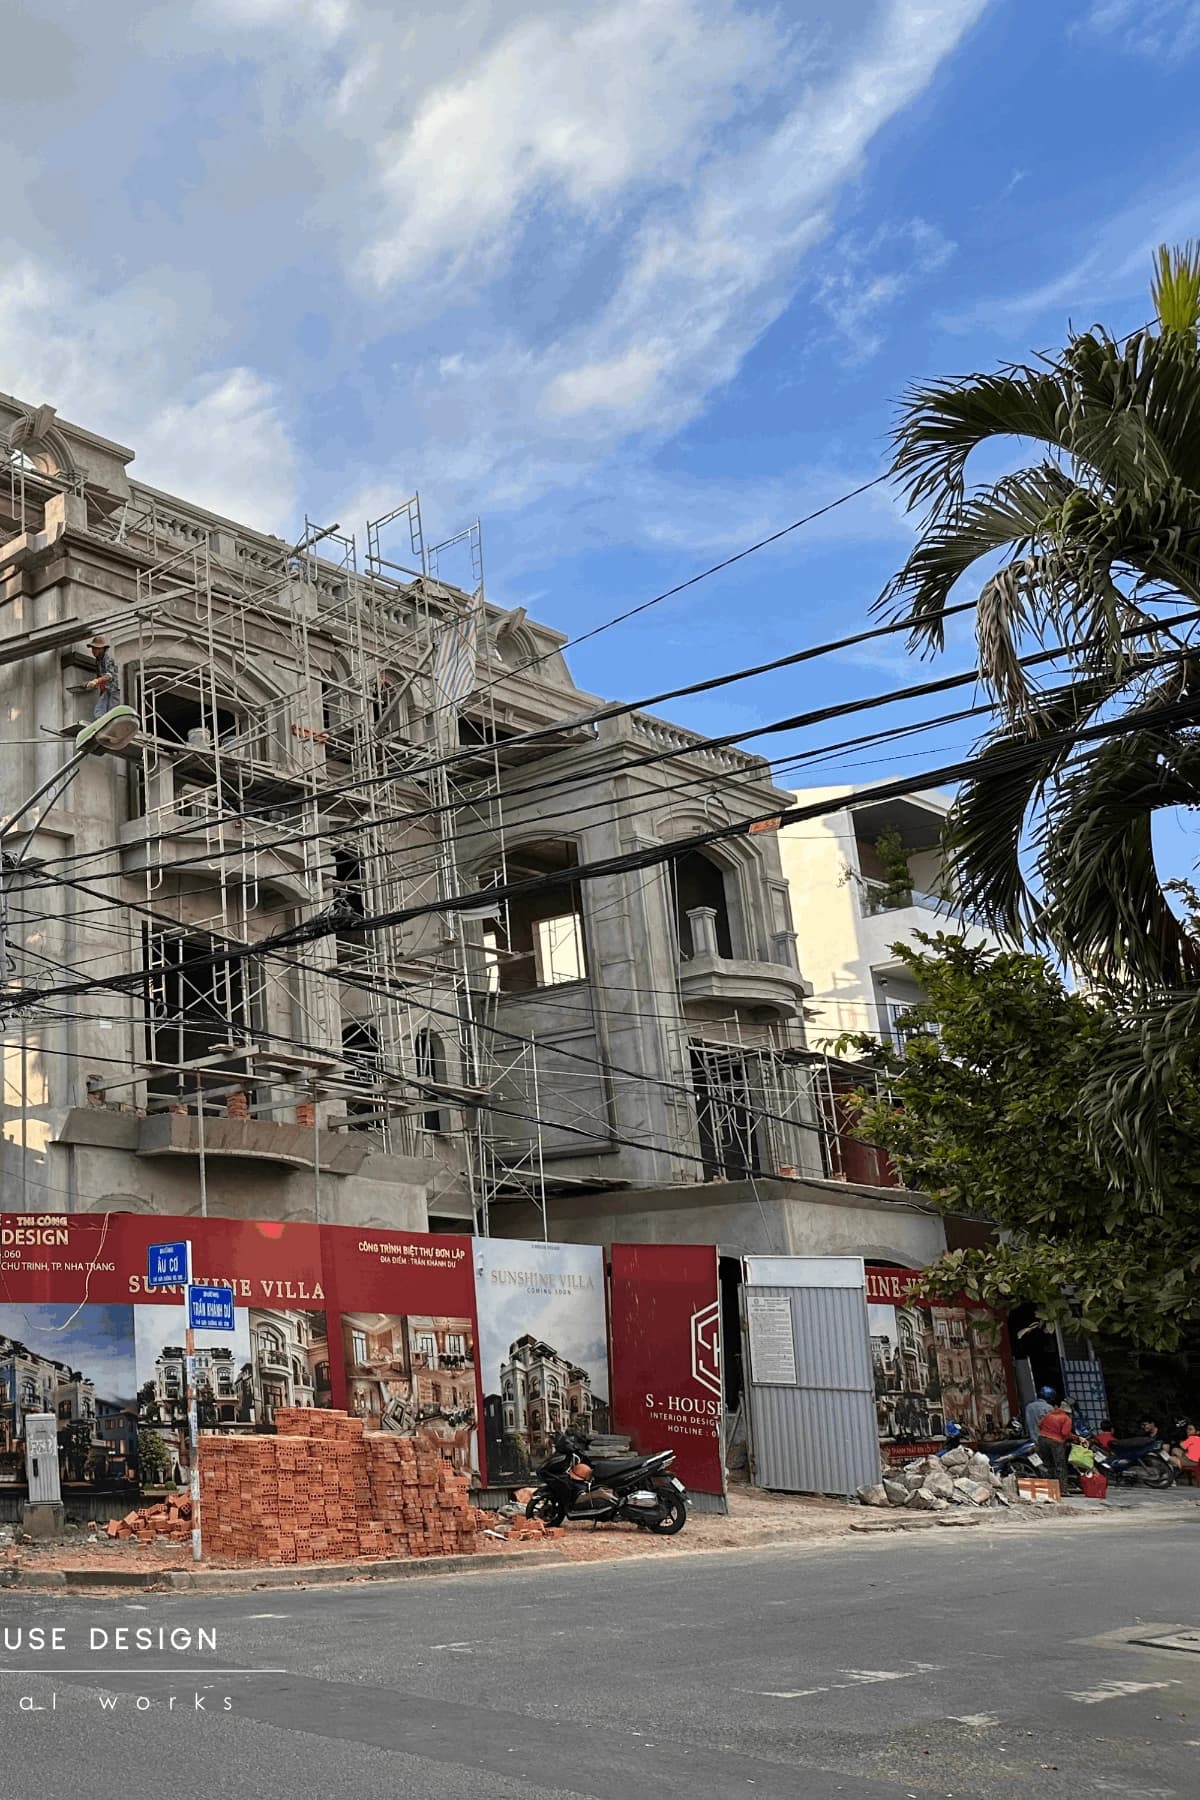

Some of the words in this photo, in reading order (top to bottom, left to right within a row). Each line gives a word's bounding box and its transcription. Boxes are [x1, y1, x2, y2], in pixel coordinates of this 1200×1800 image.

[17, 1216, 35, 1226] THI
[37, 1216, 68, 1226] CÔNG
[1, 1229, 69, 1246] DESIGN
[358, 1241, 378, 1252] CÔNG
[379, 1242, 401, 1254] TRÌNH
[1, 1263, 20, 1271] CHU
[65, 1263, 83, 1271] NHA
[85, 1262, 116, 1271] TRANG
[491, 1270, 556, 1288] SUNSHINE
[558, 1273, 595, 1290] VILLA
[261, 1280, 325, 1300] VILLA
[645, 1393, 654, 1408] S
[650, 1412, 687, 1423] INTERIOR
[667, 1424, 703, 1436] HOTLINE
